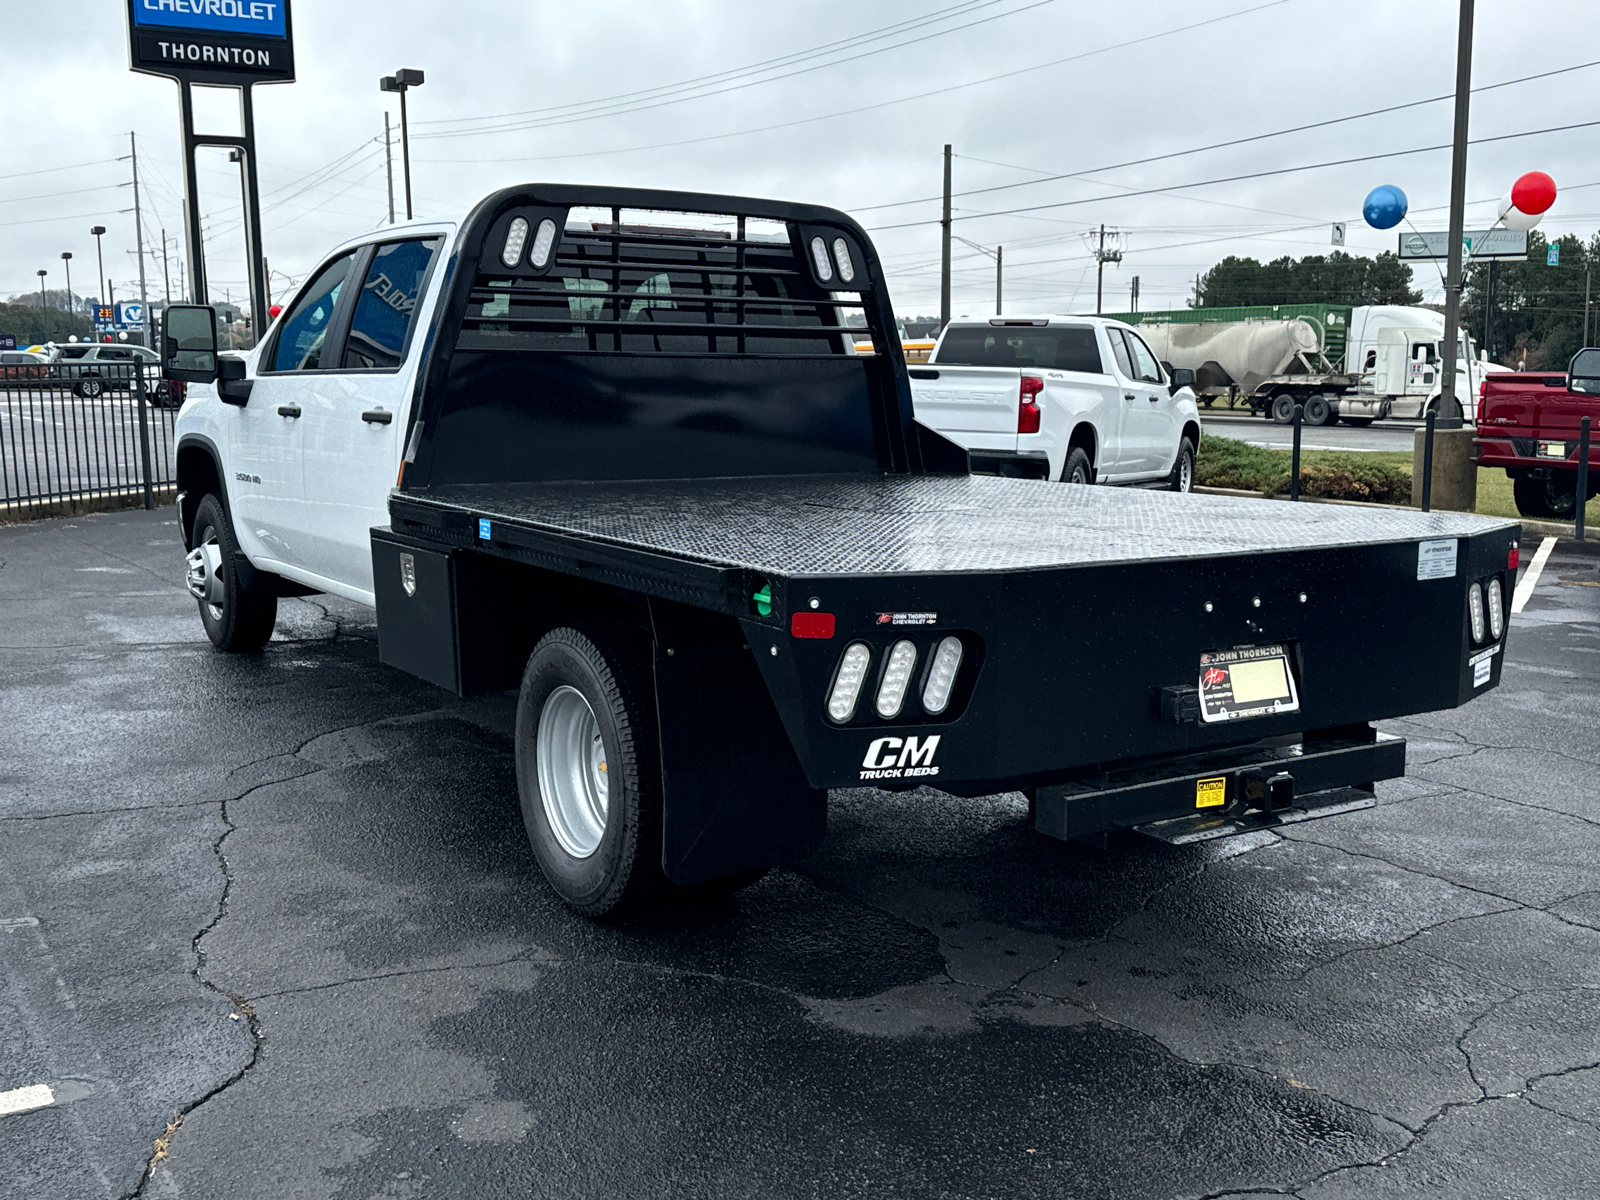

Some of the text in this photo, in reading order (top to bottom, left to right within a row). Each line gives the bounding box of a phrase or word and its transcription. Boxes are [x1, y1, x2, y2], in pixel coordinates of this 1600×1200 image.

[143, 0, 276, 21] CHEVROLET
[158, 42, 270, 66] THORNTON
[1215, 651, 1238, 662] JOHN
[862, 735, 941, 769] CM
[859, 766, 940, 780] TRUCK BEDS
[1199, 781, 1224, 791] CAUTION
